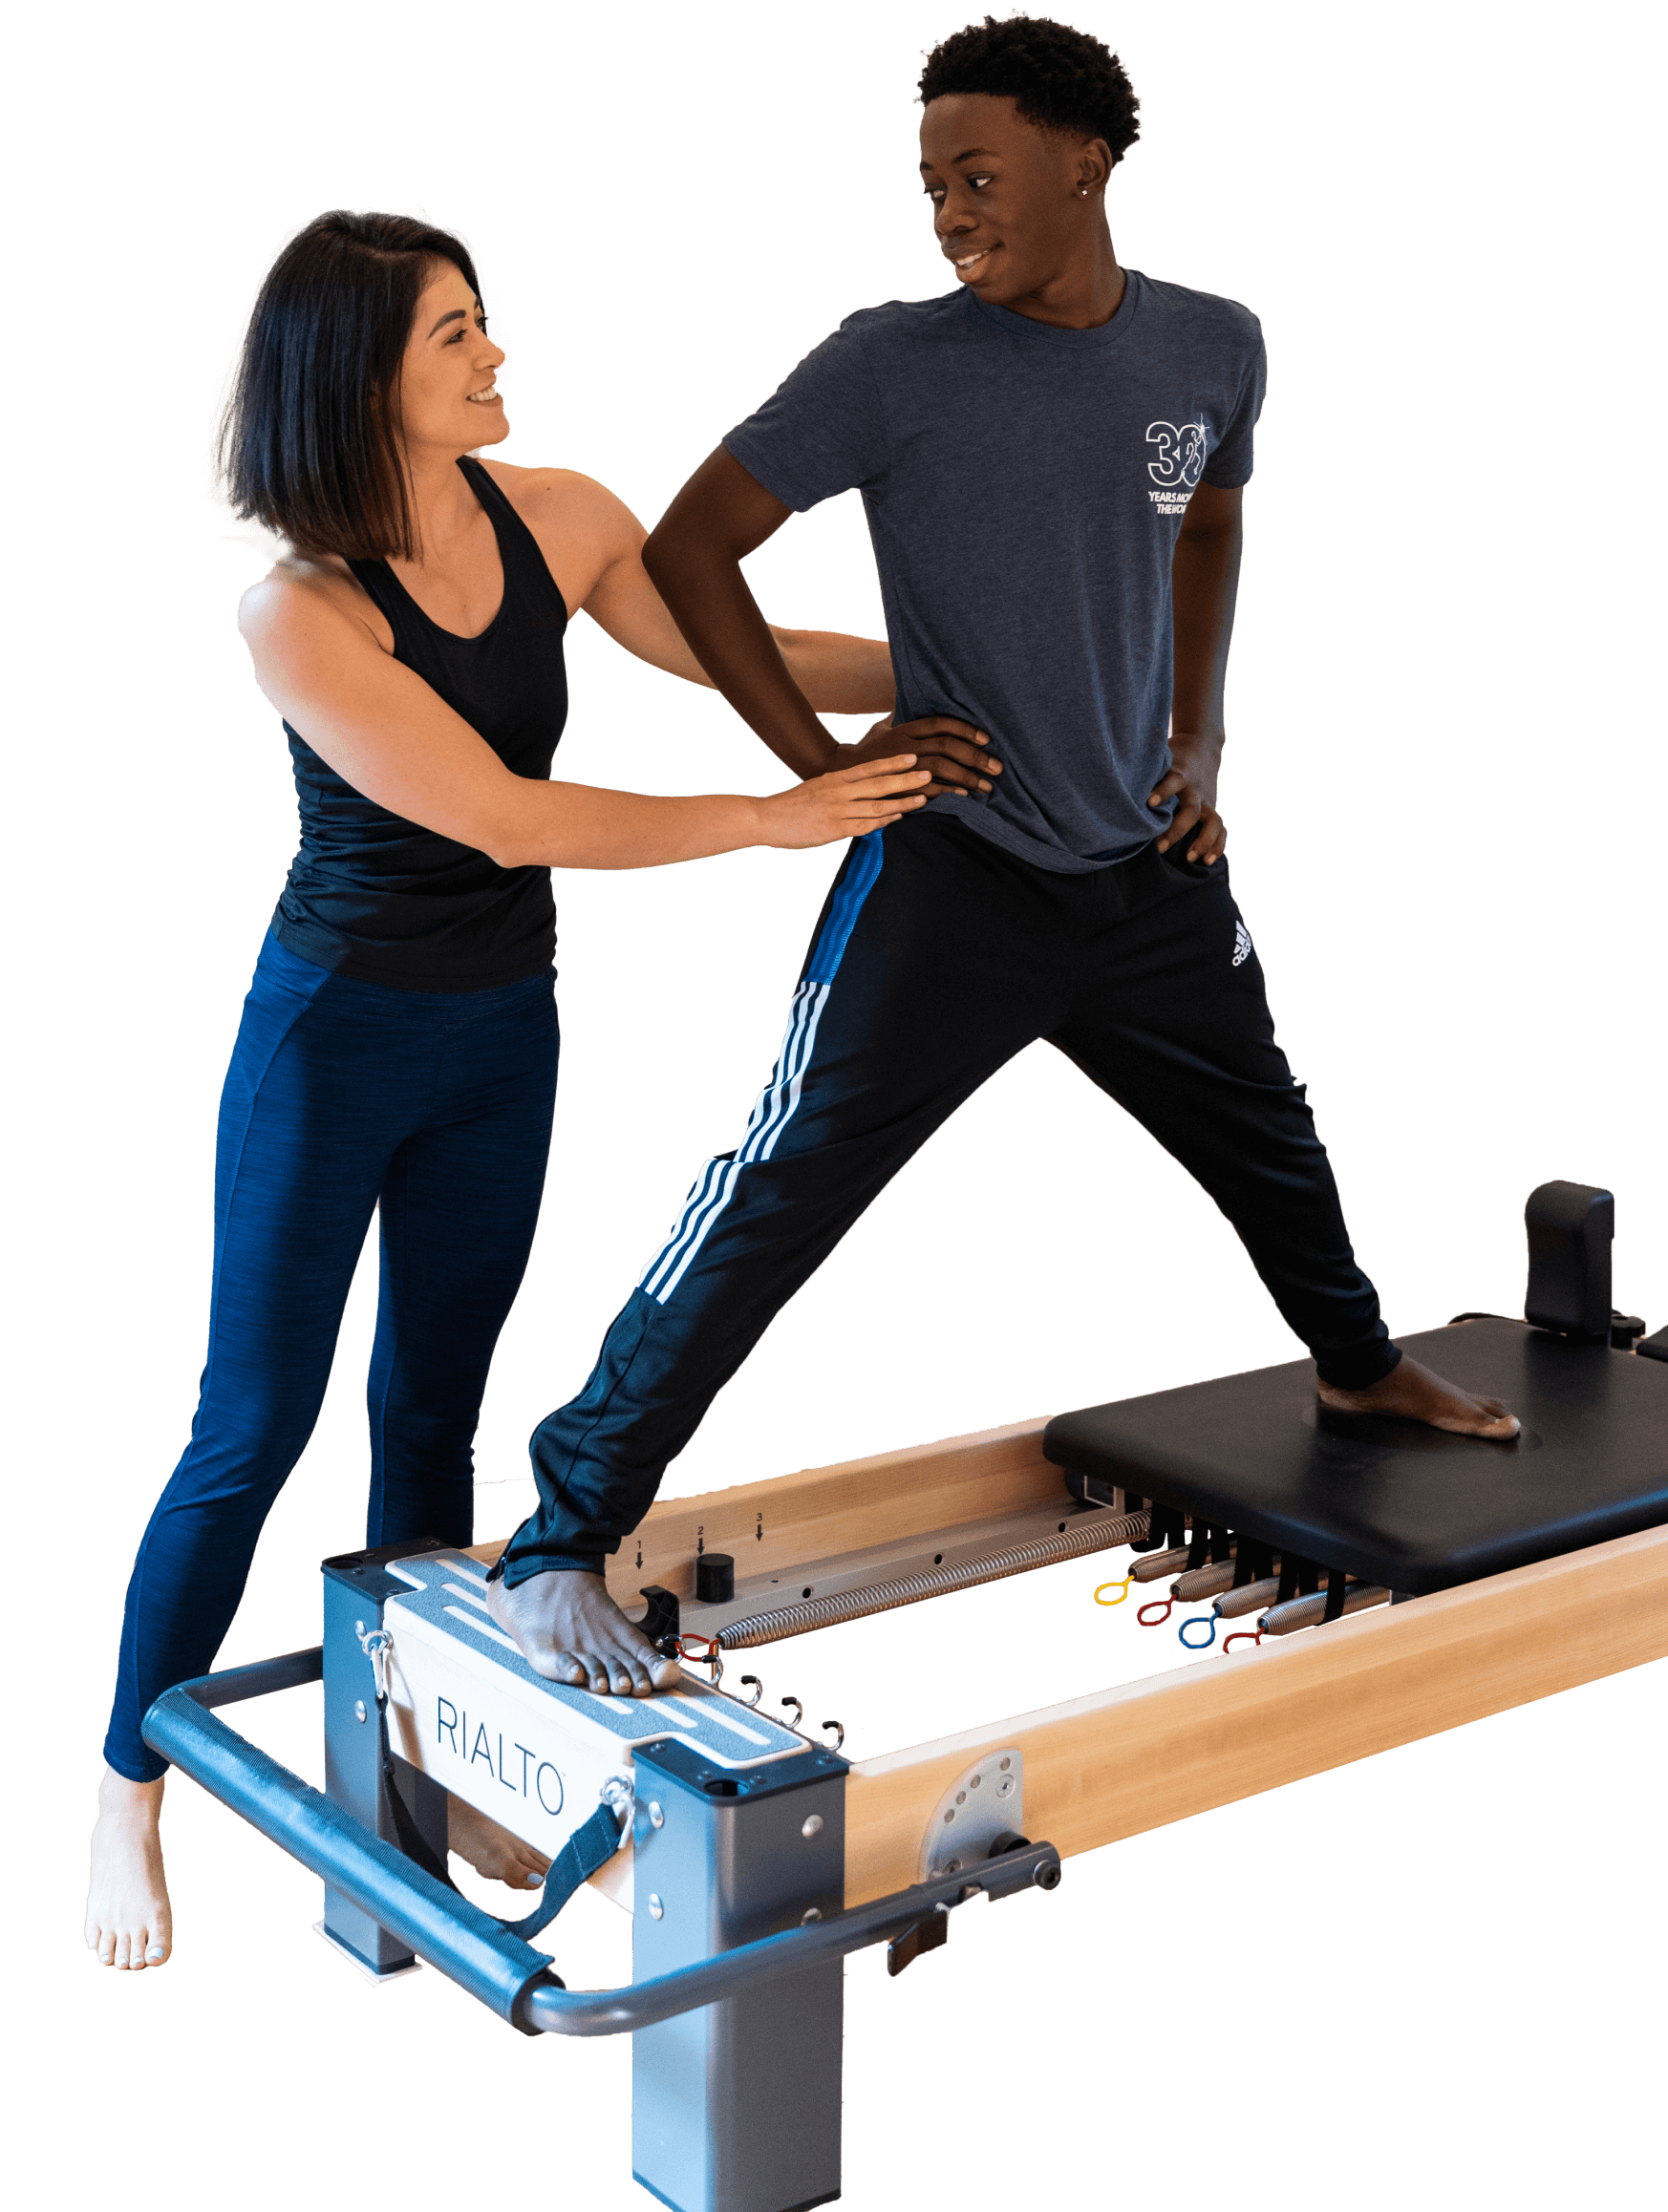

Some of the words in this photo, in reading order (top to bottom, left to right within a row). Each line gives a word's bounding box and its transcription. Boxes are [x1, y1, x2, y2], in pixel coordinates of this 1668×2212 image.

[1147, 491, 1177, 503] YEARS
[1176, 492, 1194, 503] MOV
[1156, 503, 1173, 515] THE
[756, 1512, 763, 1522] 3
[697, 1525, 705, 1536] 2
[636, 1540, 642, 1549] 1
[438, 1695, 565, 1817] RIALTO
